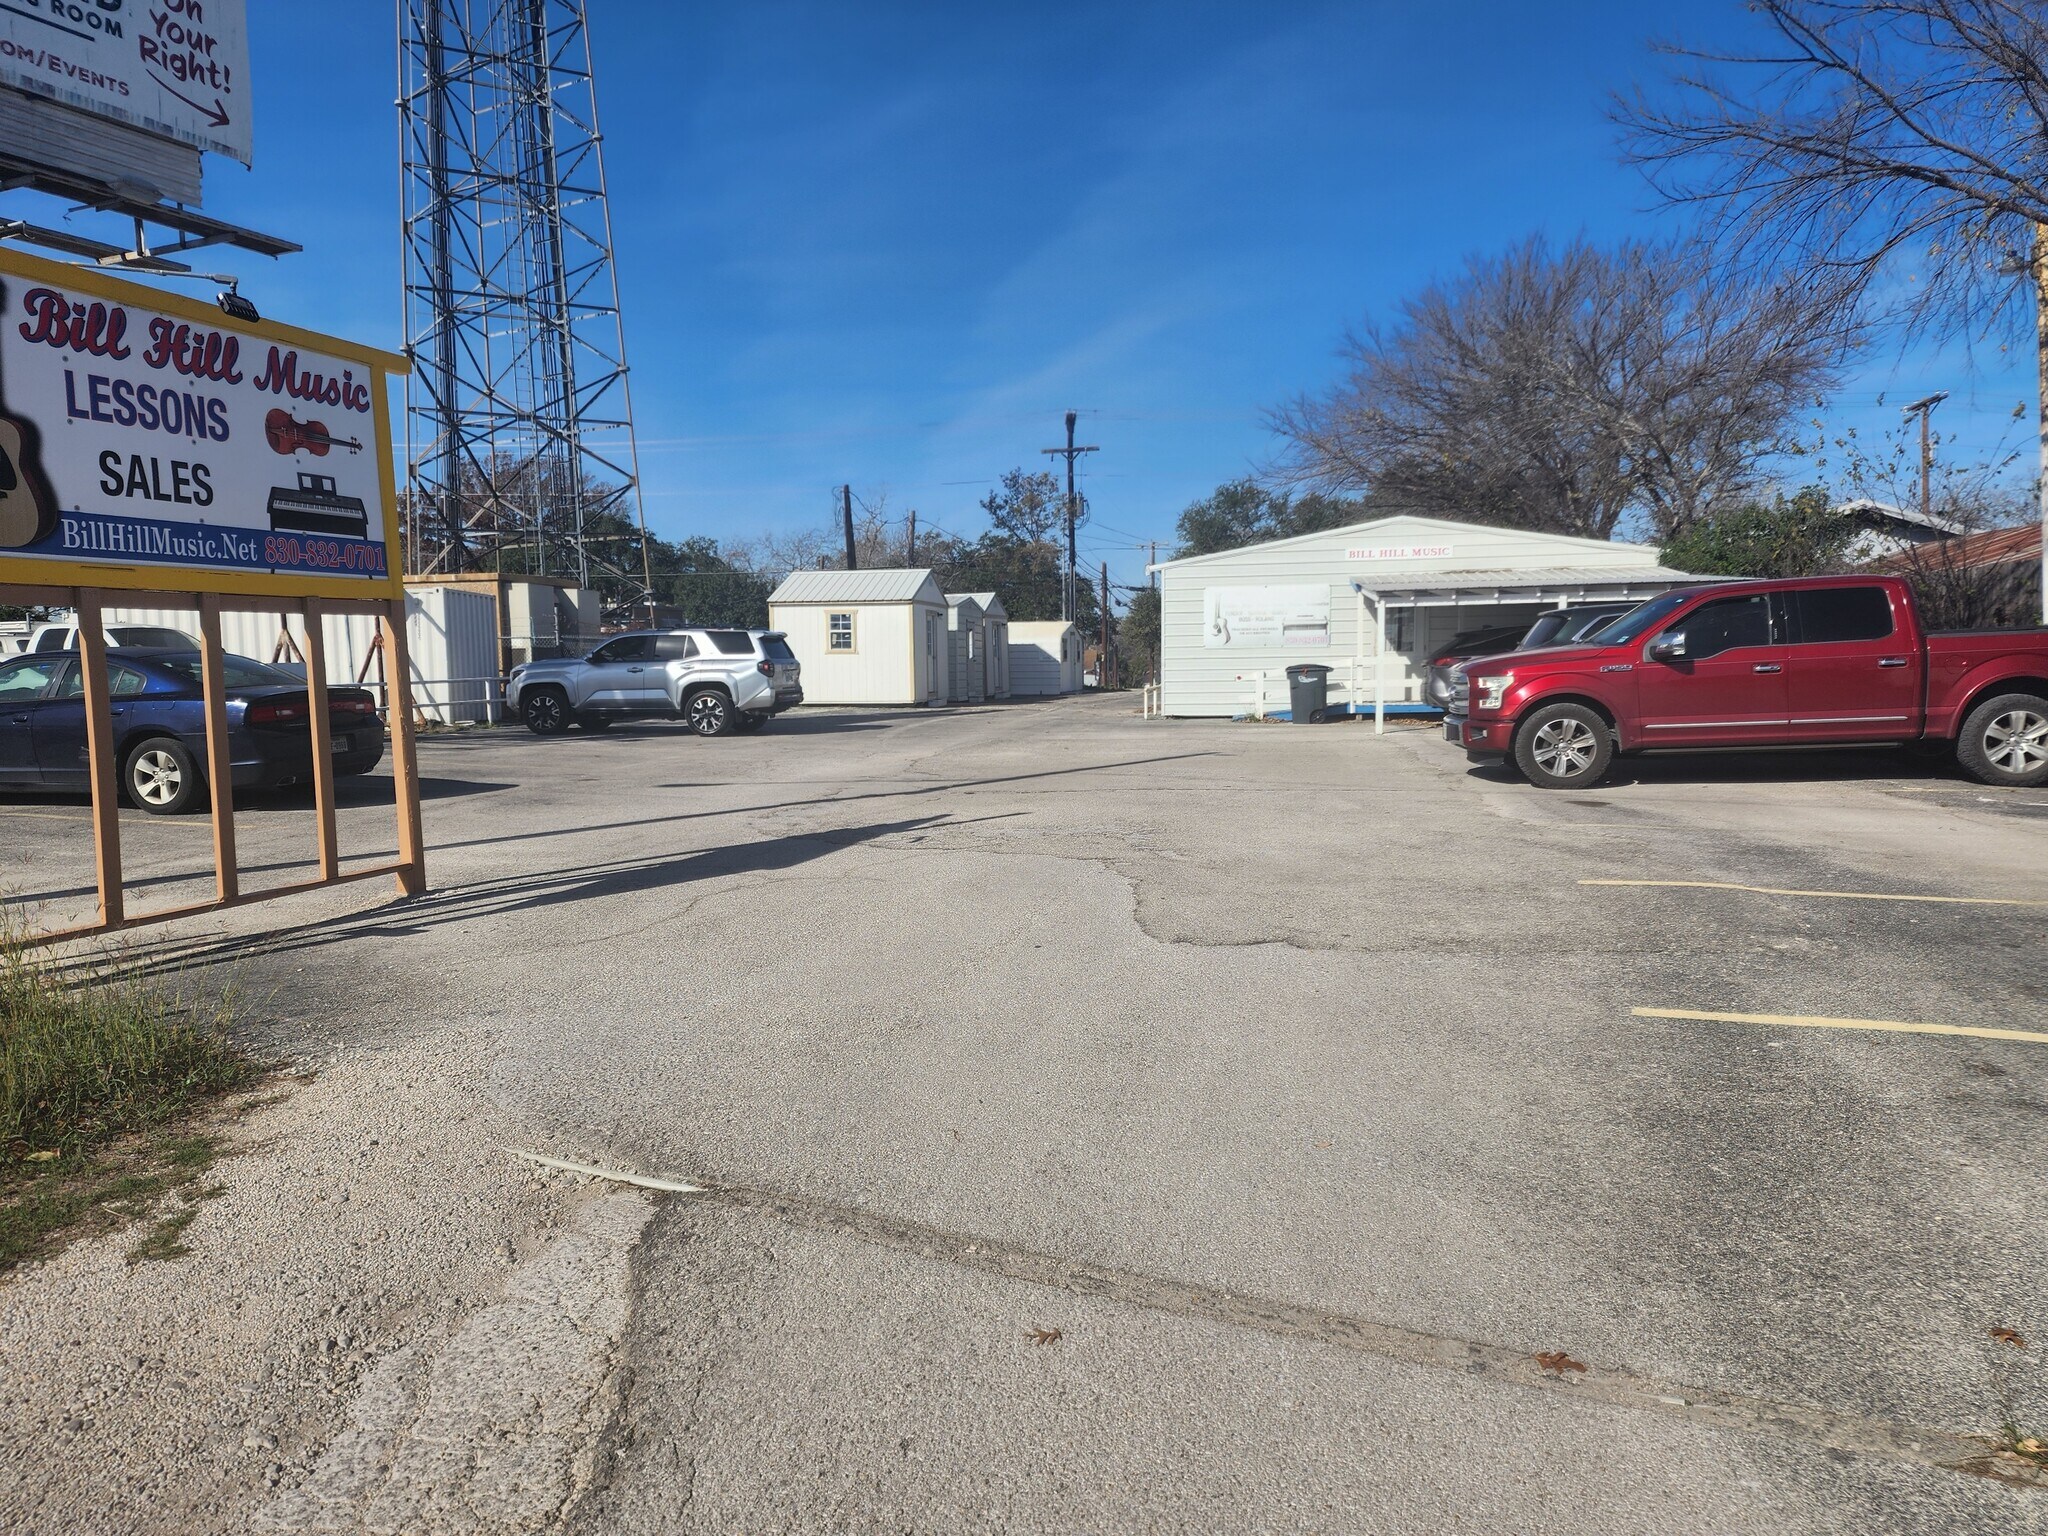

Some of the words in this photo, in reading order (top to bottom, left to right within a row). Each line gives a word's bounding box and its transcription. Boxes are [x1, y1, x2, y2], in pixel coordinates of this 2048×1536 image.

[149, 8, 218, 58] Your
[139, 34, 231, 94] Right!
[19, 288, 130, 360] Bill
[143, 317, 243, 385] Hill
[254, 346, 370, 413] Music
[64, 369, 230, 442] LESSONS
[99, 450, 214, 507] SALES
[61, 518, 258, 562] BillHillMusic.Net
[265, 536, 385, 571] 830-832-0701
[1349, 550, 1375, 559] BILL
[1379, 549, 1407, 558] HILL
[1412, 547, 1450, 557] MUSIC
